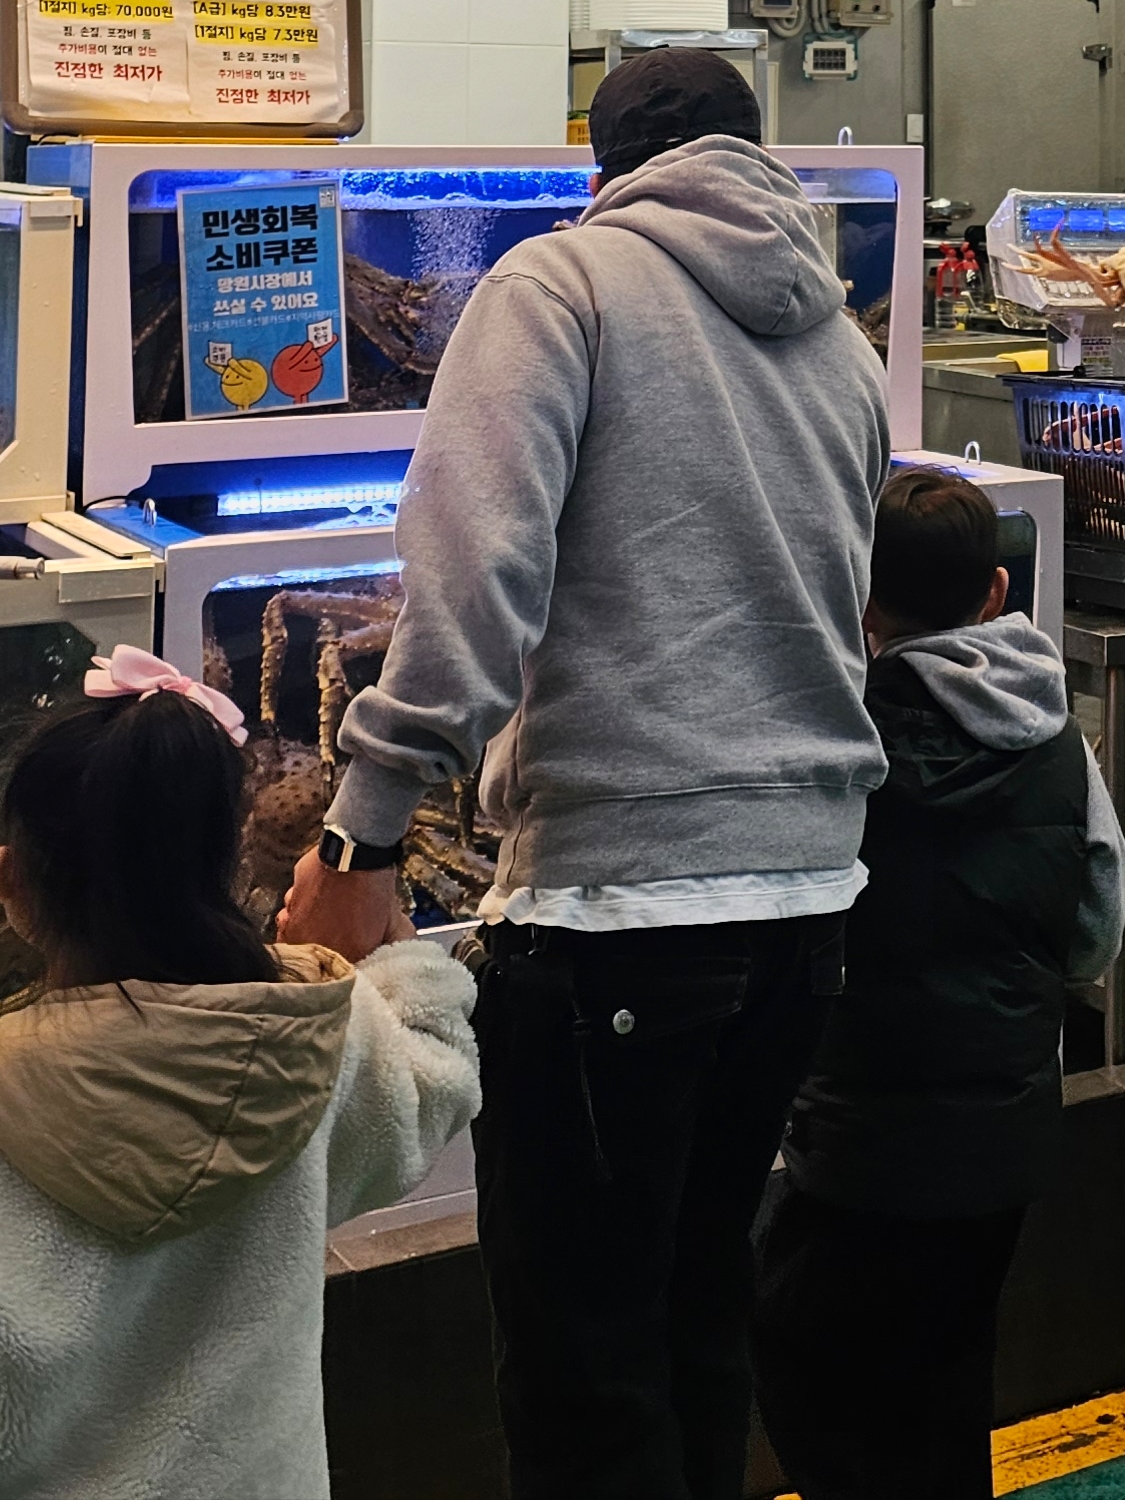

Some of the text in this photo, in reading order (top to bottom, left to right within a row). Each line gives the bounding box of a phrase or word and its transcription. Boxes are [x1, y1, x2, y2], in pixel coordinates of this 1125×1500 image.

[39, 0, 174, 18] [1절지] kg당: 70,000원
[193, 1, 311, 19] [A급] kg당 8.3만원
[107, 28, 137, 39] 포장비
[141, 29, 151, 40] 등
[194, 24, 318, 43] [1절지] kg당 7.3만원
[57, 43, 158, 57] 추가비용이 절대 없는
[261, 53, 288, 63] 포장비
[292, 53, 301, 64] 등
[54, 61, 163, 82] 진정한 최저가
[218, 69, 307, 81] 추가비용이 절대 없는
[216, 87, 311, 105] 진정한 최저가
[202, 203, 319, 238] 민생회복
[206, 236, 319, 272] 소비쿠폰
[217, 270, 313, 294] 망원시장에서
[213, 291, 319, 317] 쓰실 수 있어요
